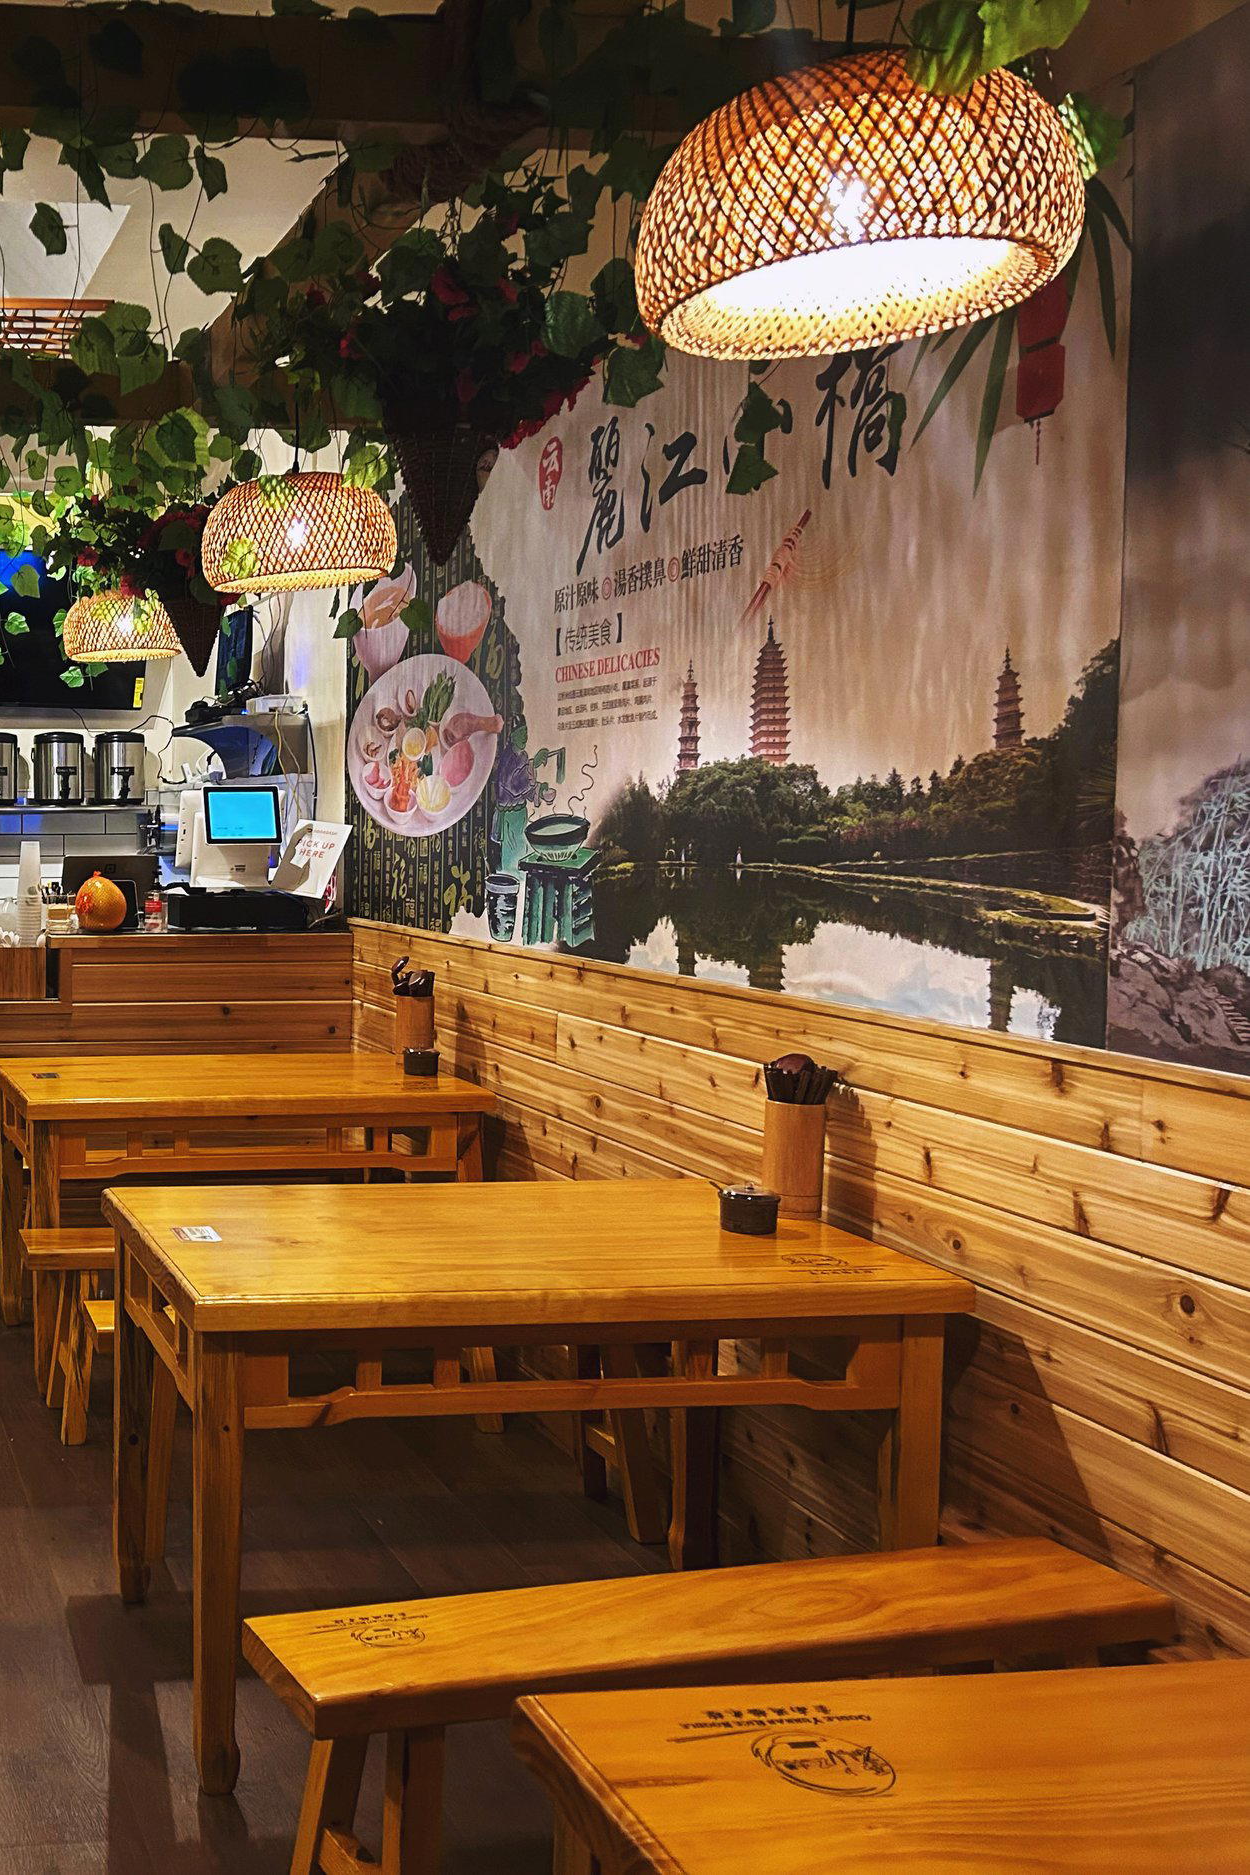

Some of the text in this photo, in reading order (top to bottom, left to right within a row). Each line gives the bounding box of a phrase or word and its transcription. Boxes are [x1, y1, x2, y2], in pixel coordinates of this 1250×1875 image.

[554, 577, 599, 614] 原汁原味
[613, 557, 667, 598] 湯香撲鼻
[555, 647, 661, 683] CHINESE DELICACIES
[299, 848, 325, 858] HERE
[322, 842, 335, 850] UP
